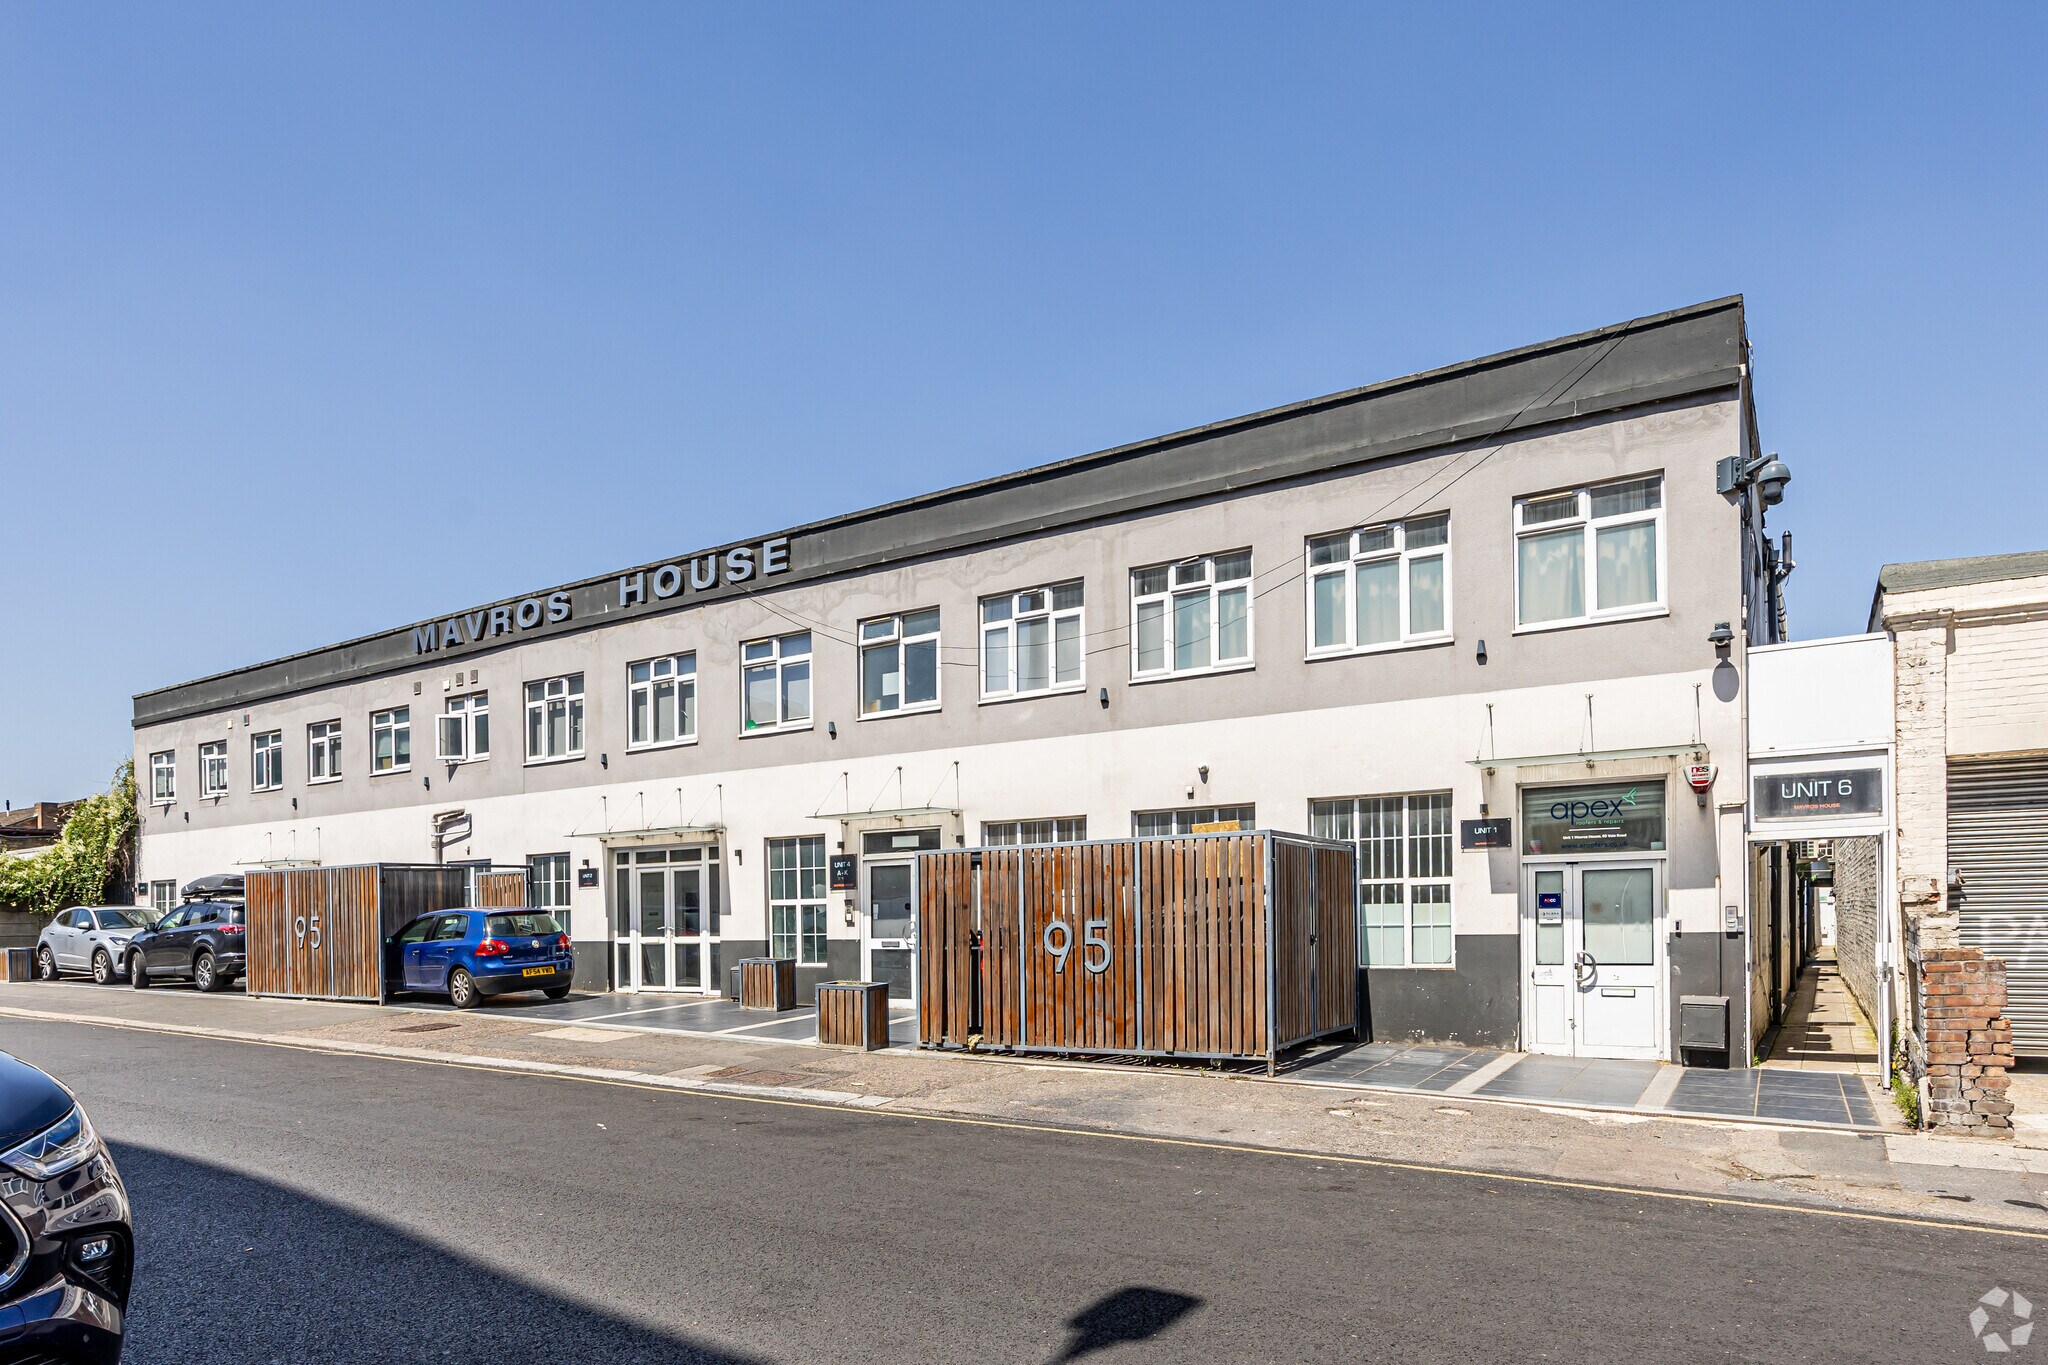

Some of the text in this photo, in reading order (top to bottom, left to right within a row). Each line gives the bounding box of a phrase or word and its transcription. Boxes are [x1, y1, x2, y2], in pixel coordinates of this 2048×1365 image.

[411, 536, 791, 656] MAVROS HOUSE
[1781, 779, 1853, 799] UNIT 6
[1550, 799, 1624, 826] apex
[1474, 826, 1498, 835] UNIT 1
[294, 915, 322, 949] 95
[1044, 920, 1112, 974] 95
